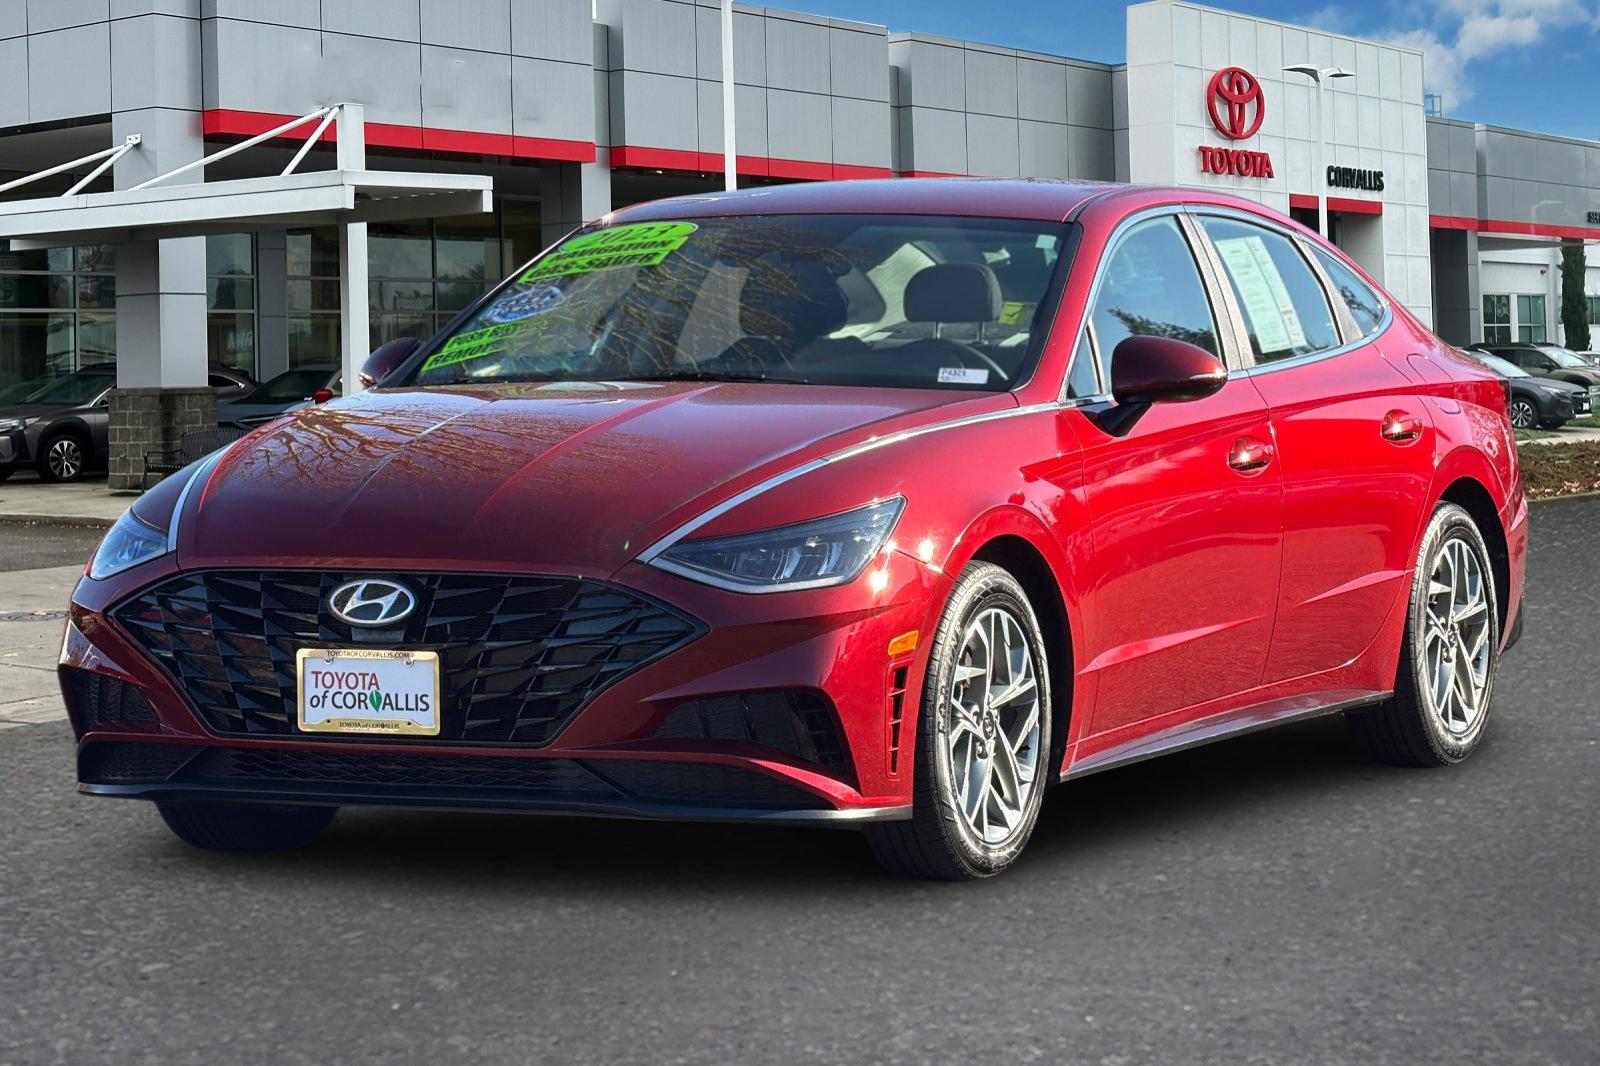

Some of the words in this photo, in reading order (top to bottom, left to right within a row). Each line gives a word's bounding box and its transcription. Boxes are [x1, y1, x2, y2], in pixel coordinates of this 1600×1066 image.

[1198, 146, 1275, 179] TOYOTA
[1326, 165, 1385, 192] CORVALLIS
[327, 650, 410, 659] TOYOTAOFCORVALLIS.COM
[311, 671, 381, 691] TOYOTA
[309, 689, 330, 709] of
[338, 721, 361, 729] TOYOTA
